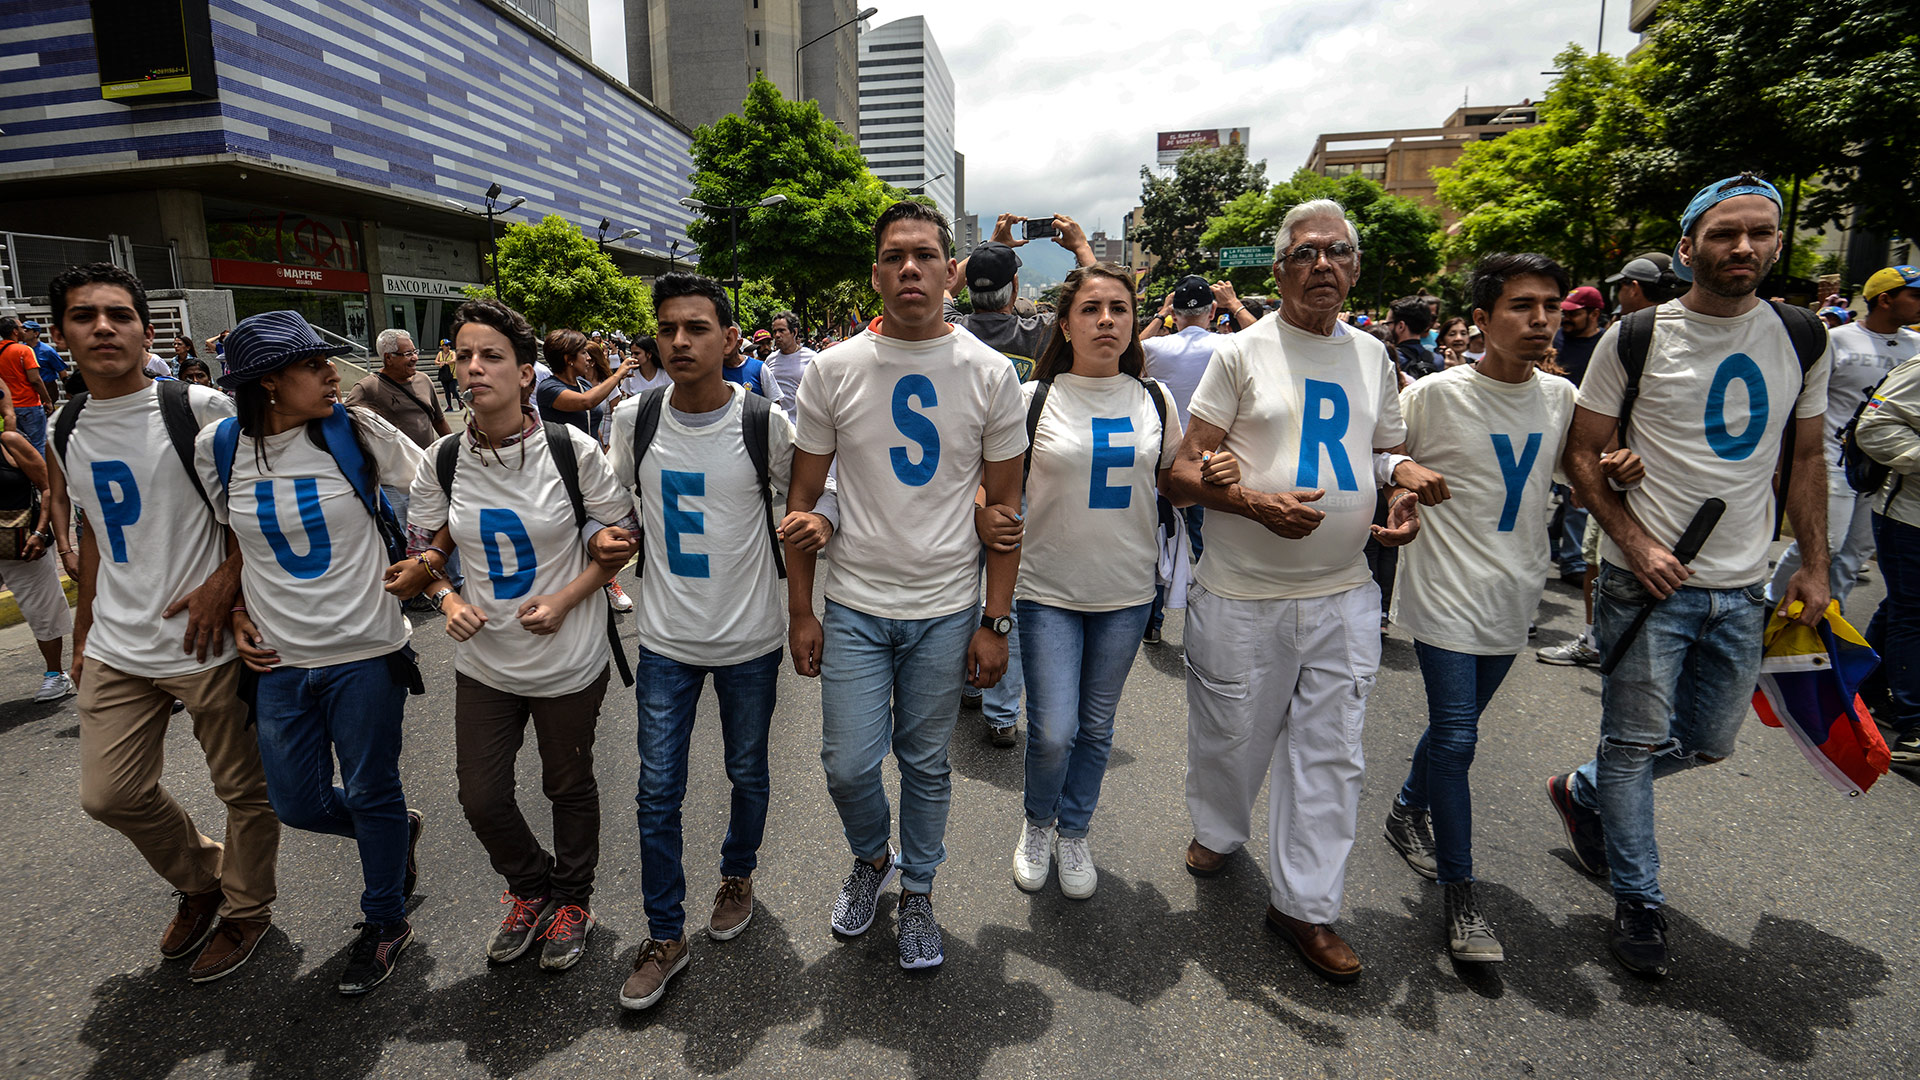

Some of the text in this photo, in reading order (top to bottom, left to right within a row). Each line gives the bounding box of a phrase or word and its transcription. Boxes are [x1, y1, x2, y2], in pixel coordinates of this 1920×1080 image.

[283, 268, 323, 281] MAPFRE
[387, 279, 450, 295] BANCO PLAZA
[889, 374, 941, 487] S
[1296, 379, 1359, 491] R
[1704, 352, 1769, 461] O
[91, 460, 142, 563] P
[1089, 417, 1135, 509] E
[1490, 433, 1542, 532] Y
[254, 478, 332, 579] U
[480, 508, 537, 600] D
[661, 470, 710, 578] E
